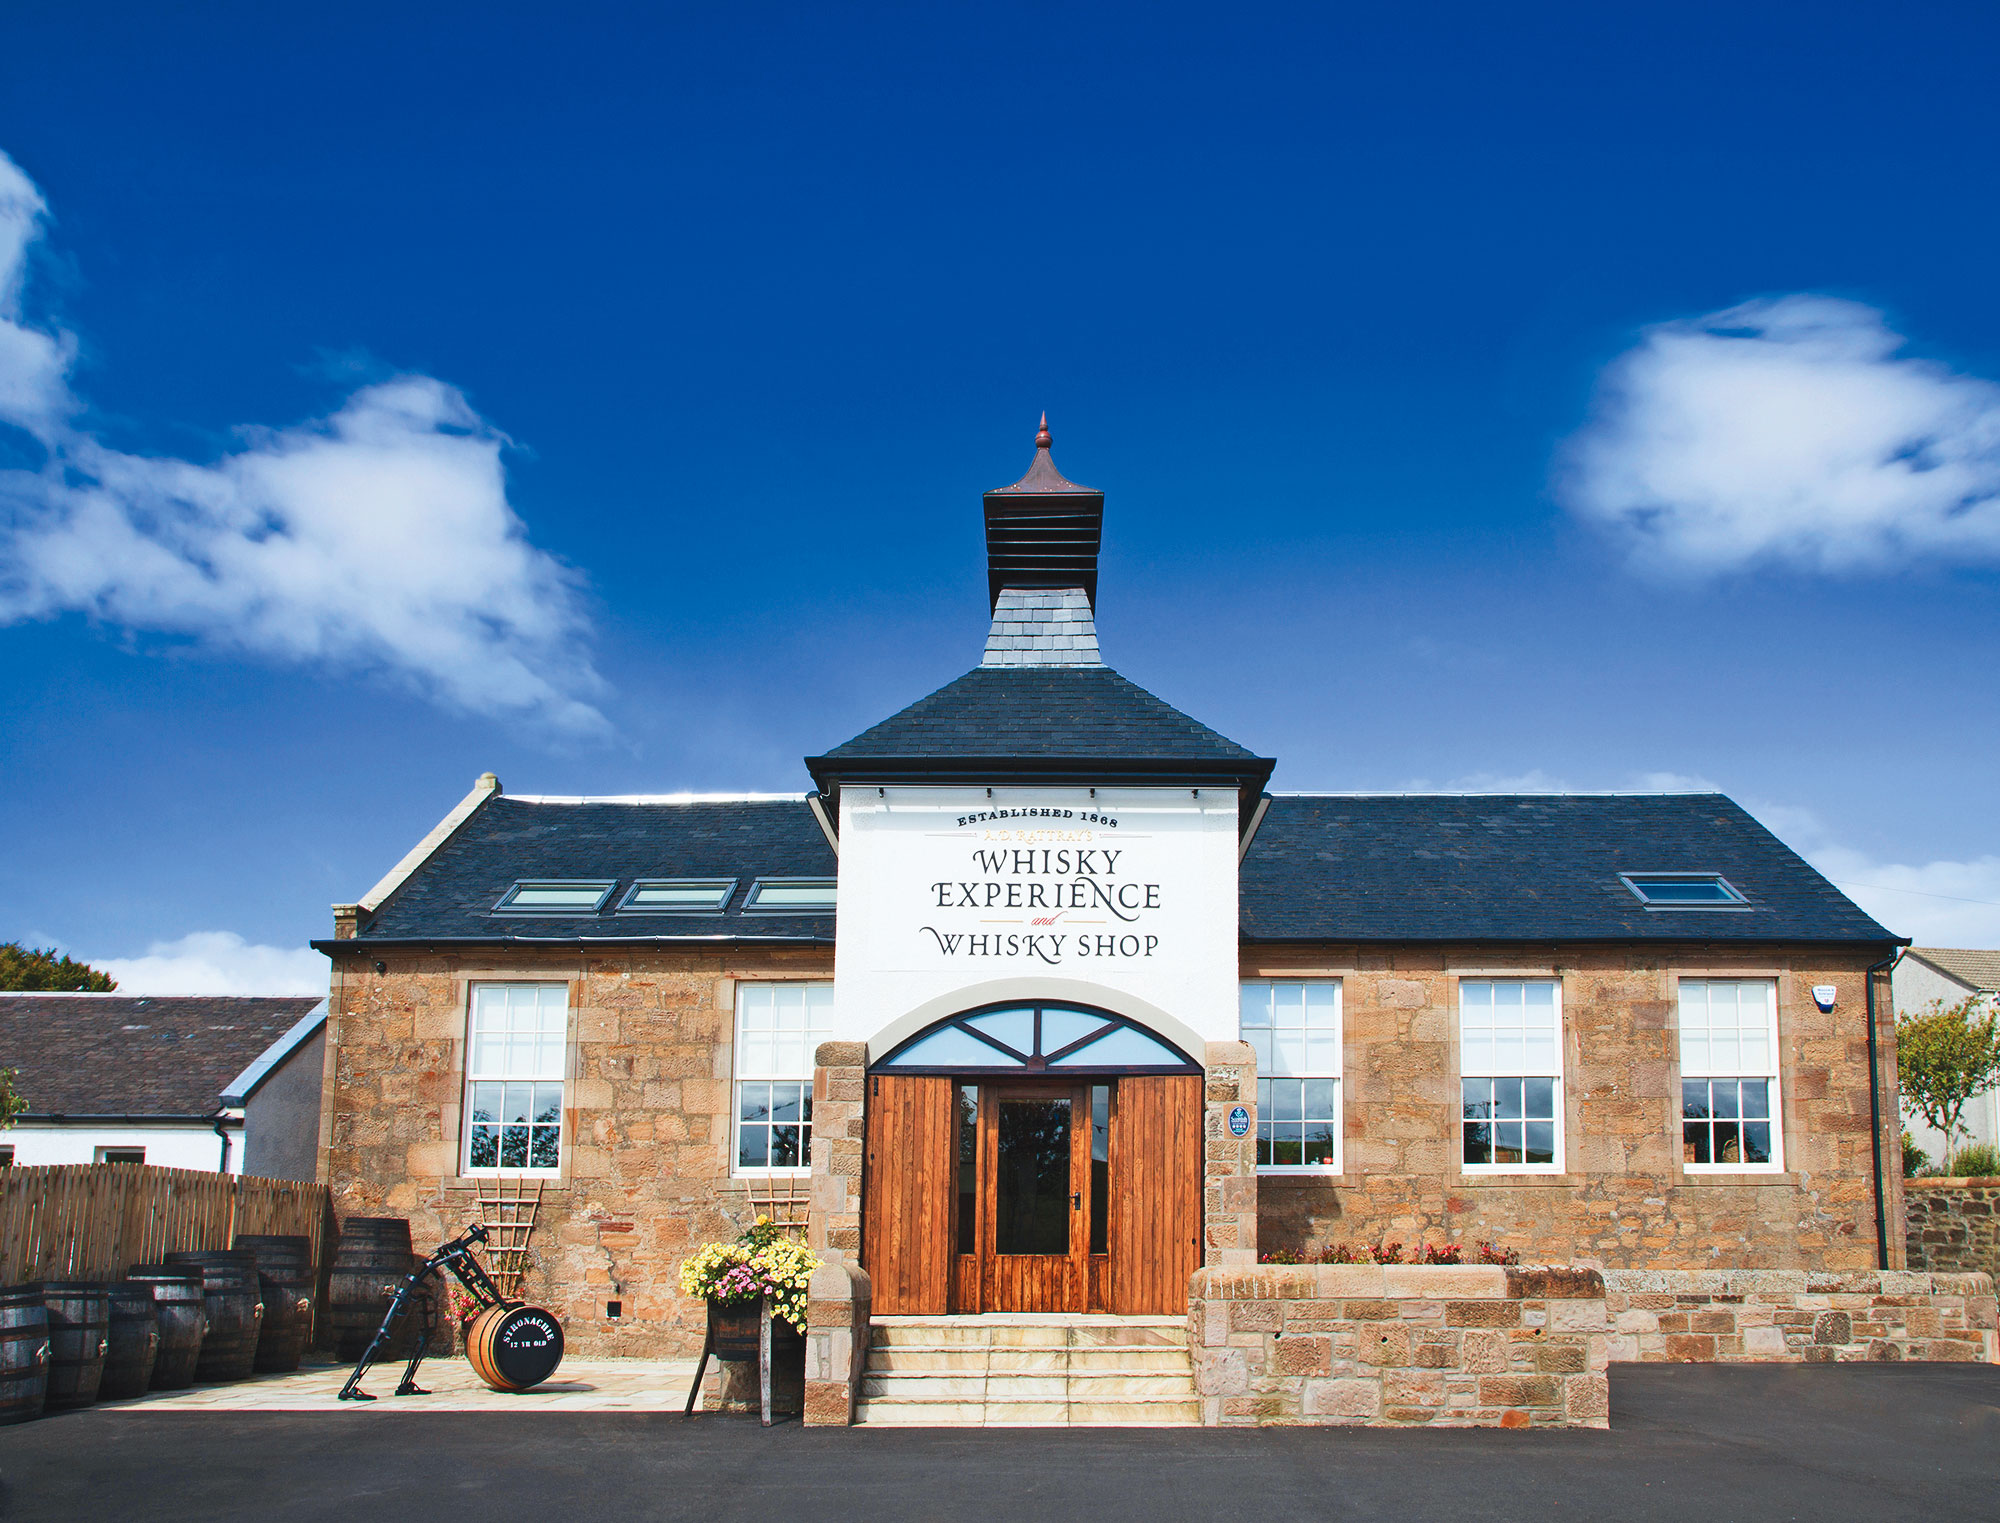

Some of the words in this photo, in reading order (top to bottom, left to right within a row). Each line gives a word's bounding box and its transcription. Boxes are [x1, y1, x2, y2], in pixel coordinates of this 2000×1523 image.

[957, 808, 1073, 827] ESTABLISHED
[1080, 812, 1119, 828] 1868
[984, 830, 1012, 841] A.D.
[973, 849, 1122, 875] WHISKY
[931, 877, 1161, 922] EXPERIENCE
[1031, 911, 1068, 926] and
[919, 926, 1067, 965] WHISKY
[1078, 934, 1159, 957] SHOP
[503, 1316, 555, 1343] STRONACHIE
